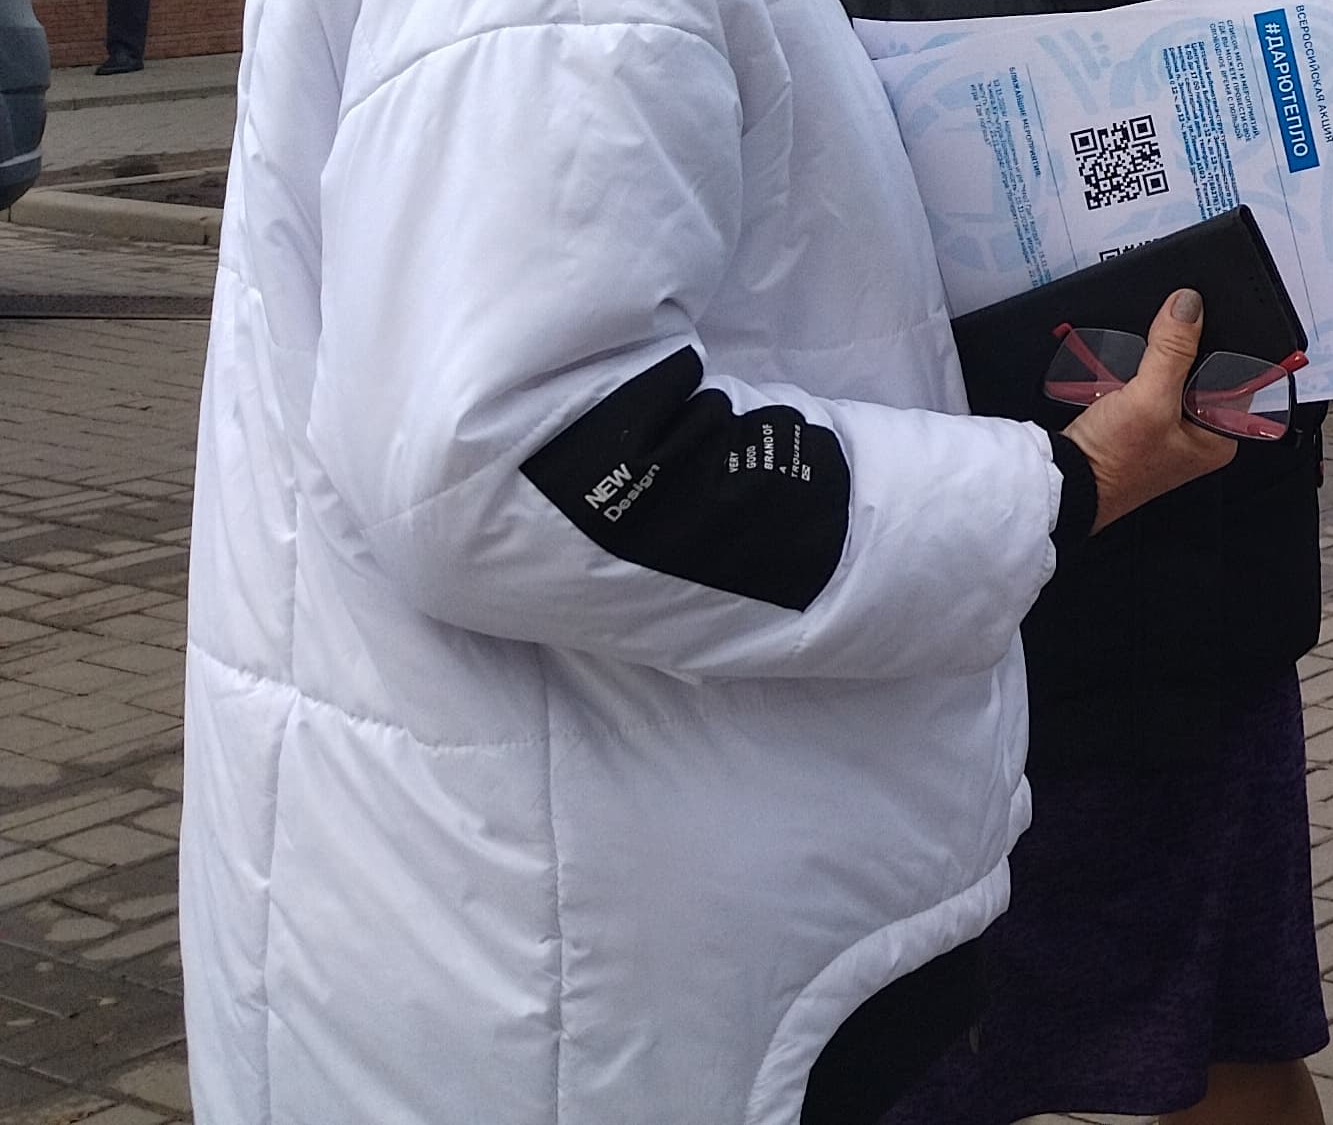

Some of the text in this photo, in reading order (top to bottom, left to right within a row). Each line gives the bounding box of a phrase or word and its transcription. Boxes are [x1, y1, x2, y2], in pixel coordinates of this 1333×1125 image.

[1226, 18, 1239, 50] СПИСОК
[1234, 51, 1244, 71] МЕСТ
[1217, 20, 1226, 34] ГДЕ
[1224, 48, 1237, 81] МОЖЕТЕ
[1232, 81, 1246, 122] ПРОВЕСТИ
[1220, 69, 1231, 95] ВРЕМЯ
[1262, 21, 1309, 158] #ДАРЮТЕПЛО
[1294, 4, 1333, 142] ВСЕРОССИЙСКАЯ АКЦИЯ
[729, 451, 739, 473] VERY
[746, 445, 757, 469] GOOD
[762, 423, 774, 470] BRAND OF
[779, 466, 787, 474] A
[584, 463, 632, 509] NEW
[603, 464, 660, 522] Design
